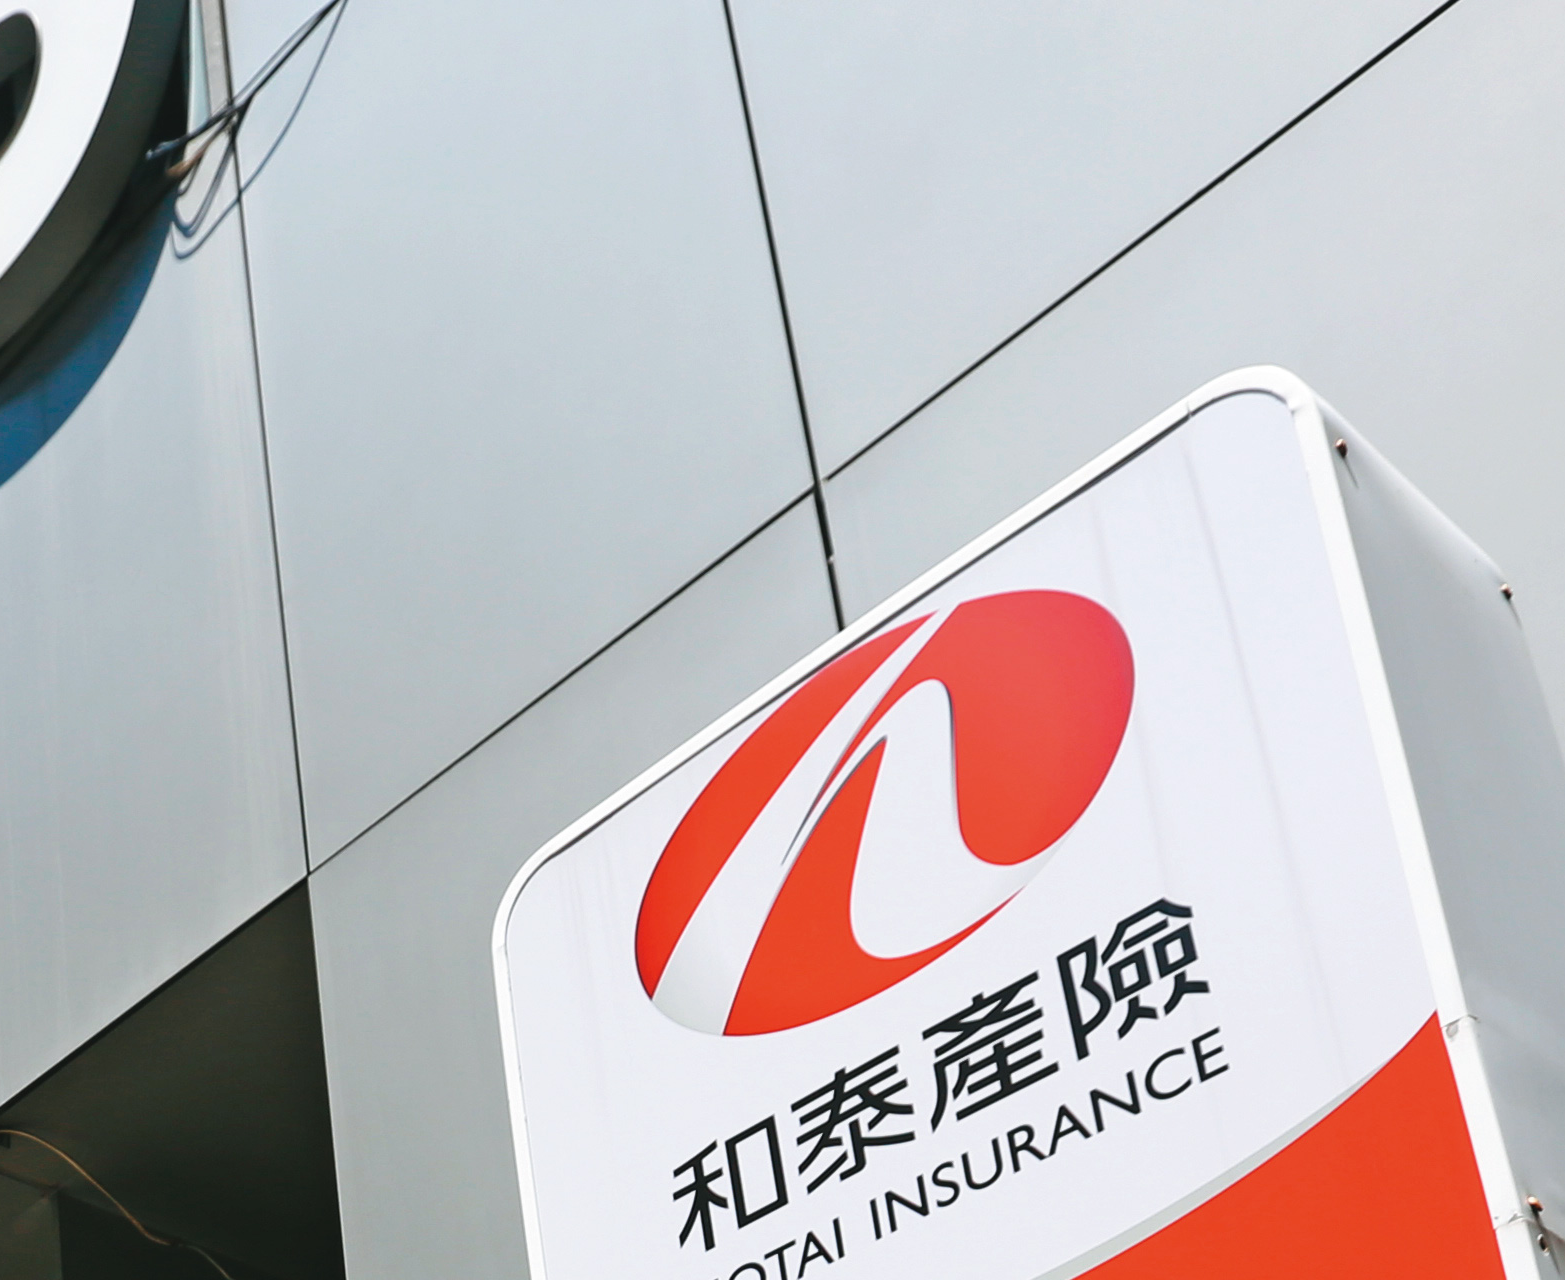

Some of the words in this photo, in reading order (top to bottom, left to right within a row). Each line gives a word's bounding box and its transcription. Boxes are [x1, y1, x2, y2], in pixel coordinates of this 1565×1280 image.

[672, 897, 1210, 1252] 和泰產險
[869, 1027, 1230, 1241] INSURANCE
